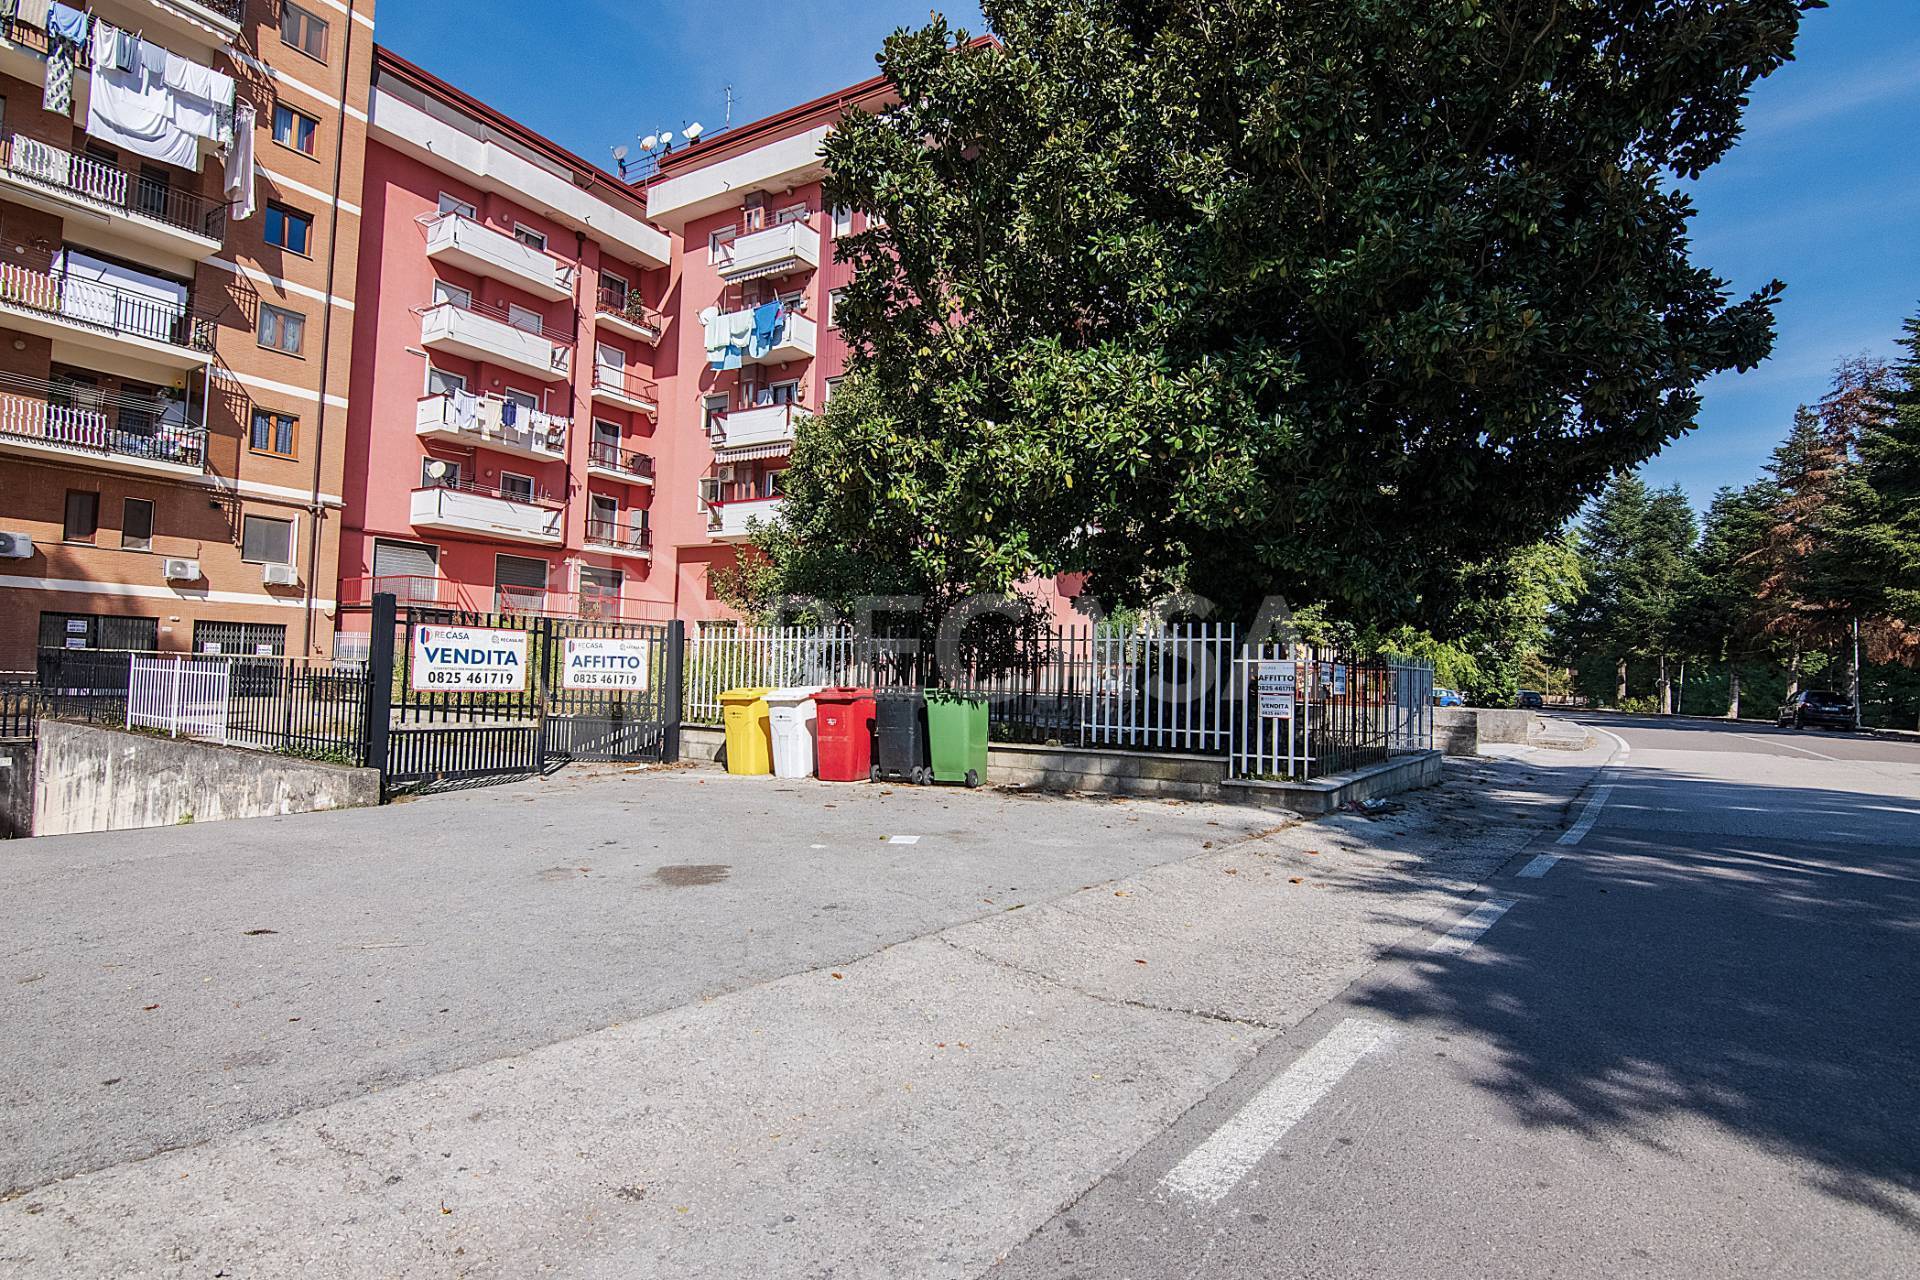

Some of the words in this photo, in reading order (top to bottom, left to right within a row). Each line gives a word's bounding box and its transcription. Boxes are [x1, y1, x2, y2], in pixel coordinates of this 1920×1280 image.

[434, 631, 469, 640] RECASA
[424, 647, 518, 666] VENDITA
[572, 655, 640, 669] AFFITTO
[428, 671, 461, 684] 0825
[467, 673, 513, 684] 461719
[573, 674, 597, 683] 0825
[601, 675, 637, 685] 461719
[1258, 674, 1294, 682] AFFITTO
